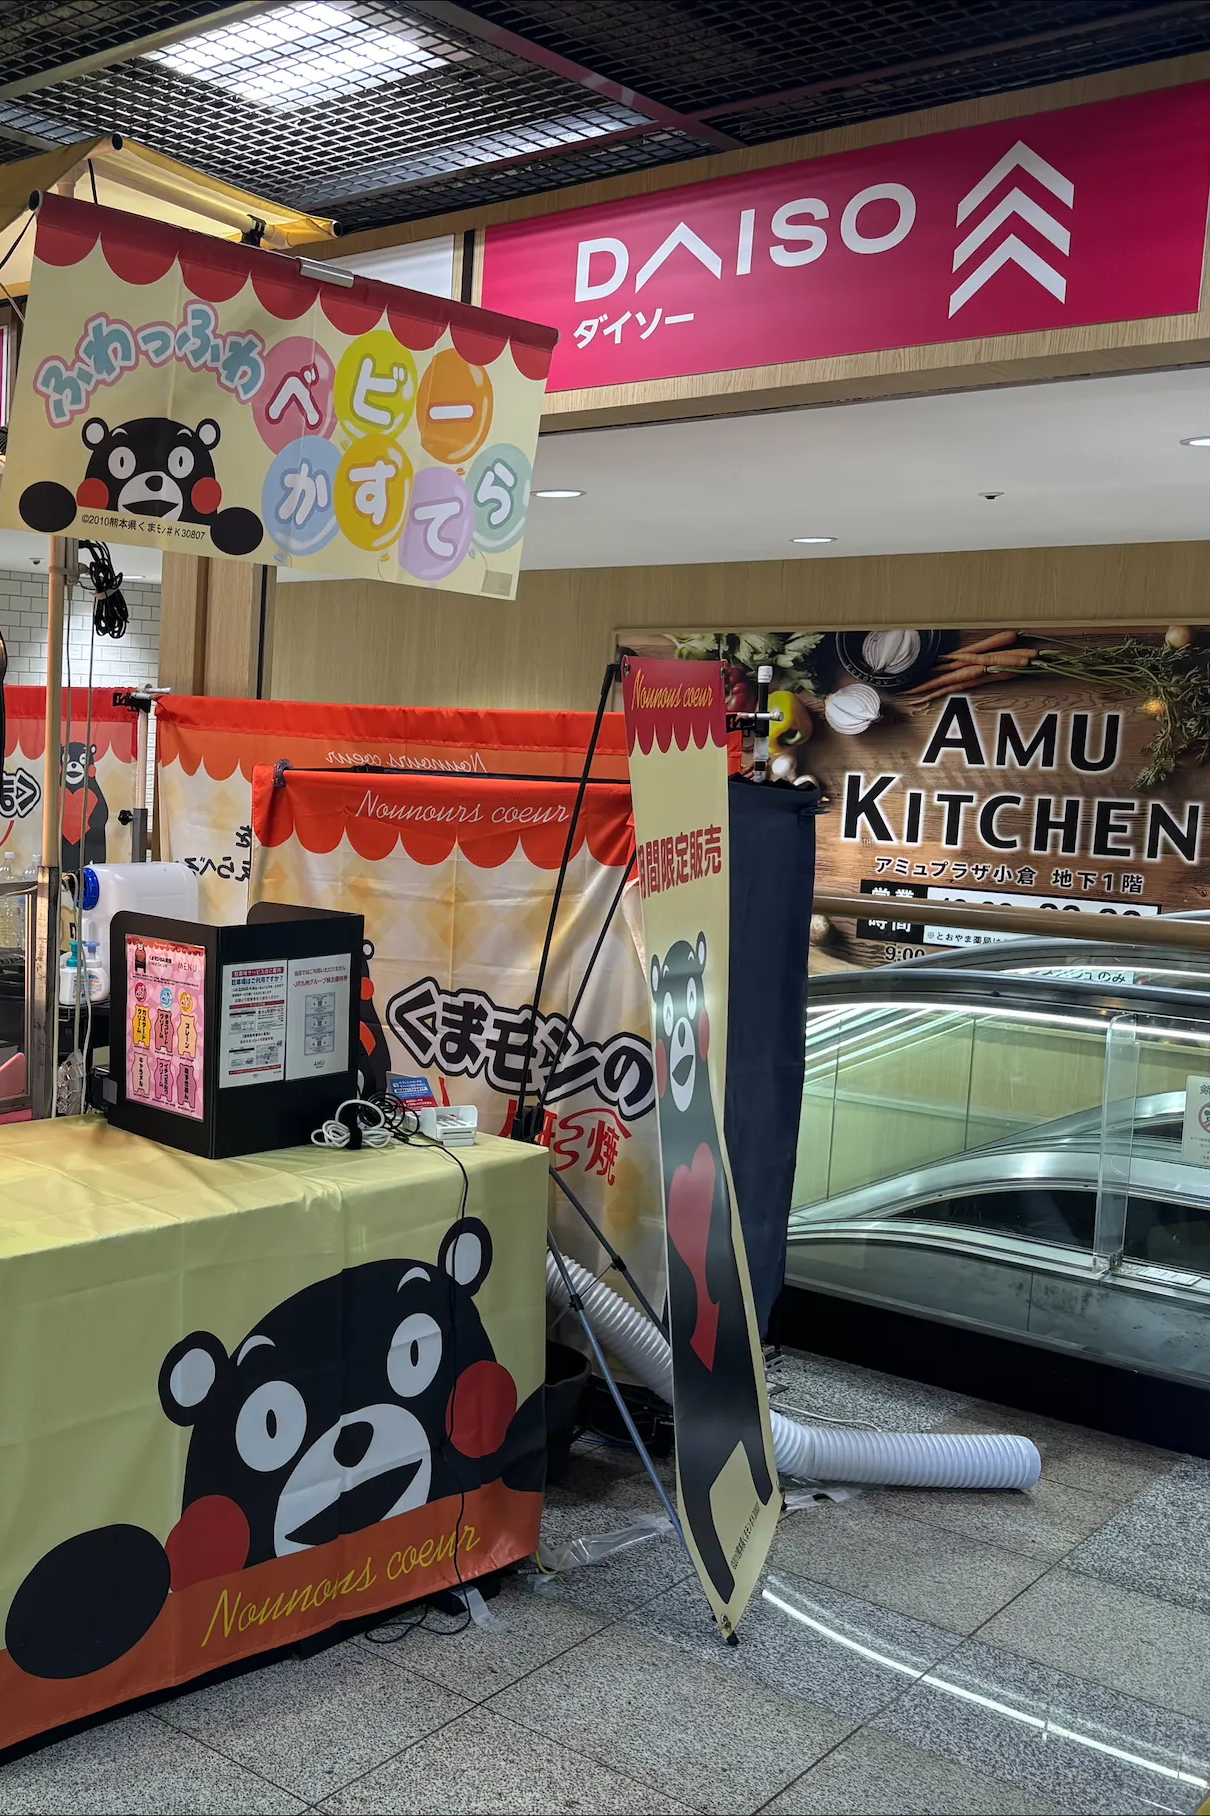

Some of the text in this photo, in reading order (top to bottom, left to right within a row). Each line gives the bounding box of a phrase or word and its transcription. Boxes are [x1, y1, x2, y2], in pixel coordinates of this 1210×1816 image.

[575, 181, 917, 303] DAISO
[573, 309, 695, 350] ダイソー
[277, 459, 517, 560] かすてら
[922, 696, 1121, 770] AMU
[492, 803, 569, 824] coeur
[842, 774, 1200, 863] KITCHEN
[876, 856, 1145, 895] アミュプラザ小倉 地下1階
[177, 962, 197, 972] MENU
[390, 983, 655, 1112] くまモンの
[386, 1524, 481, 1581] coeur
